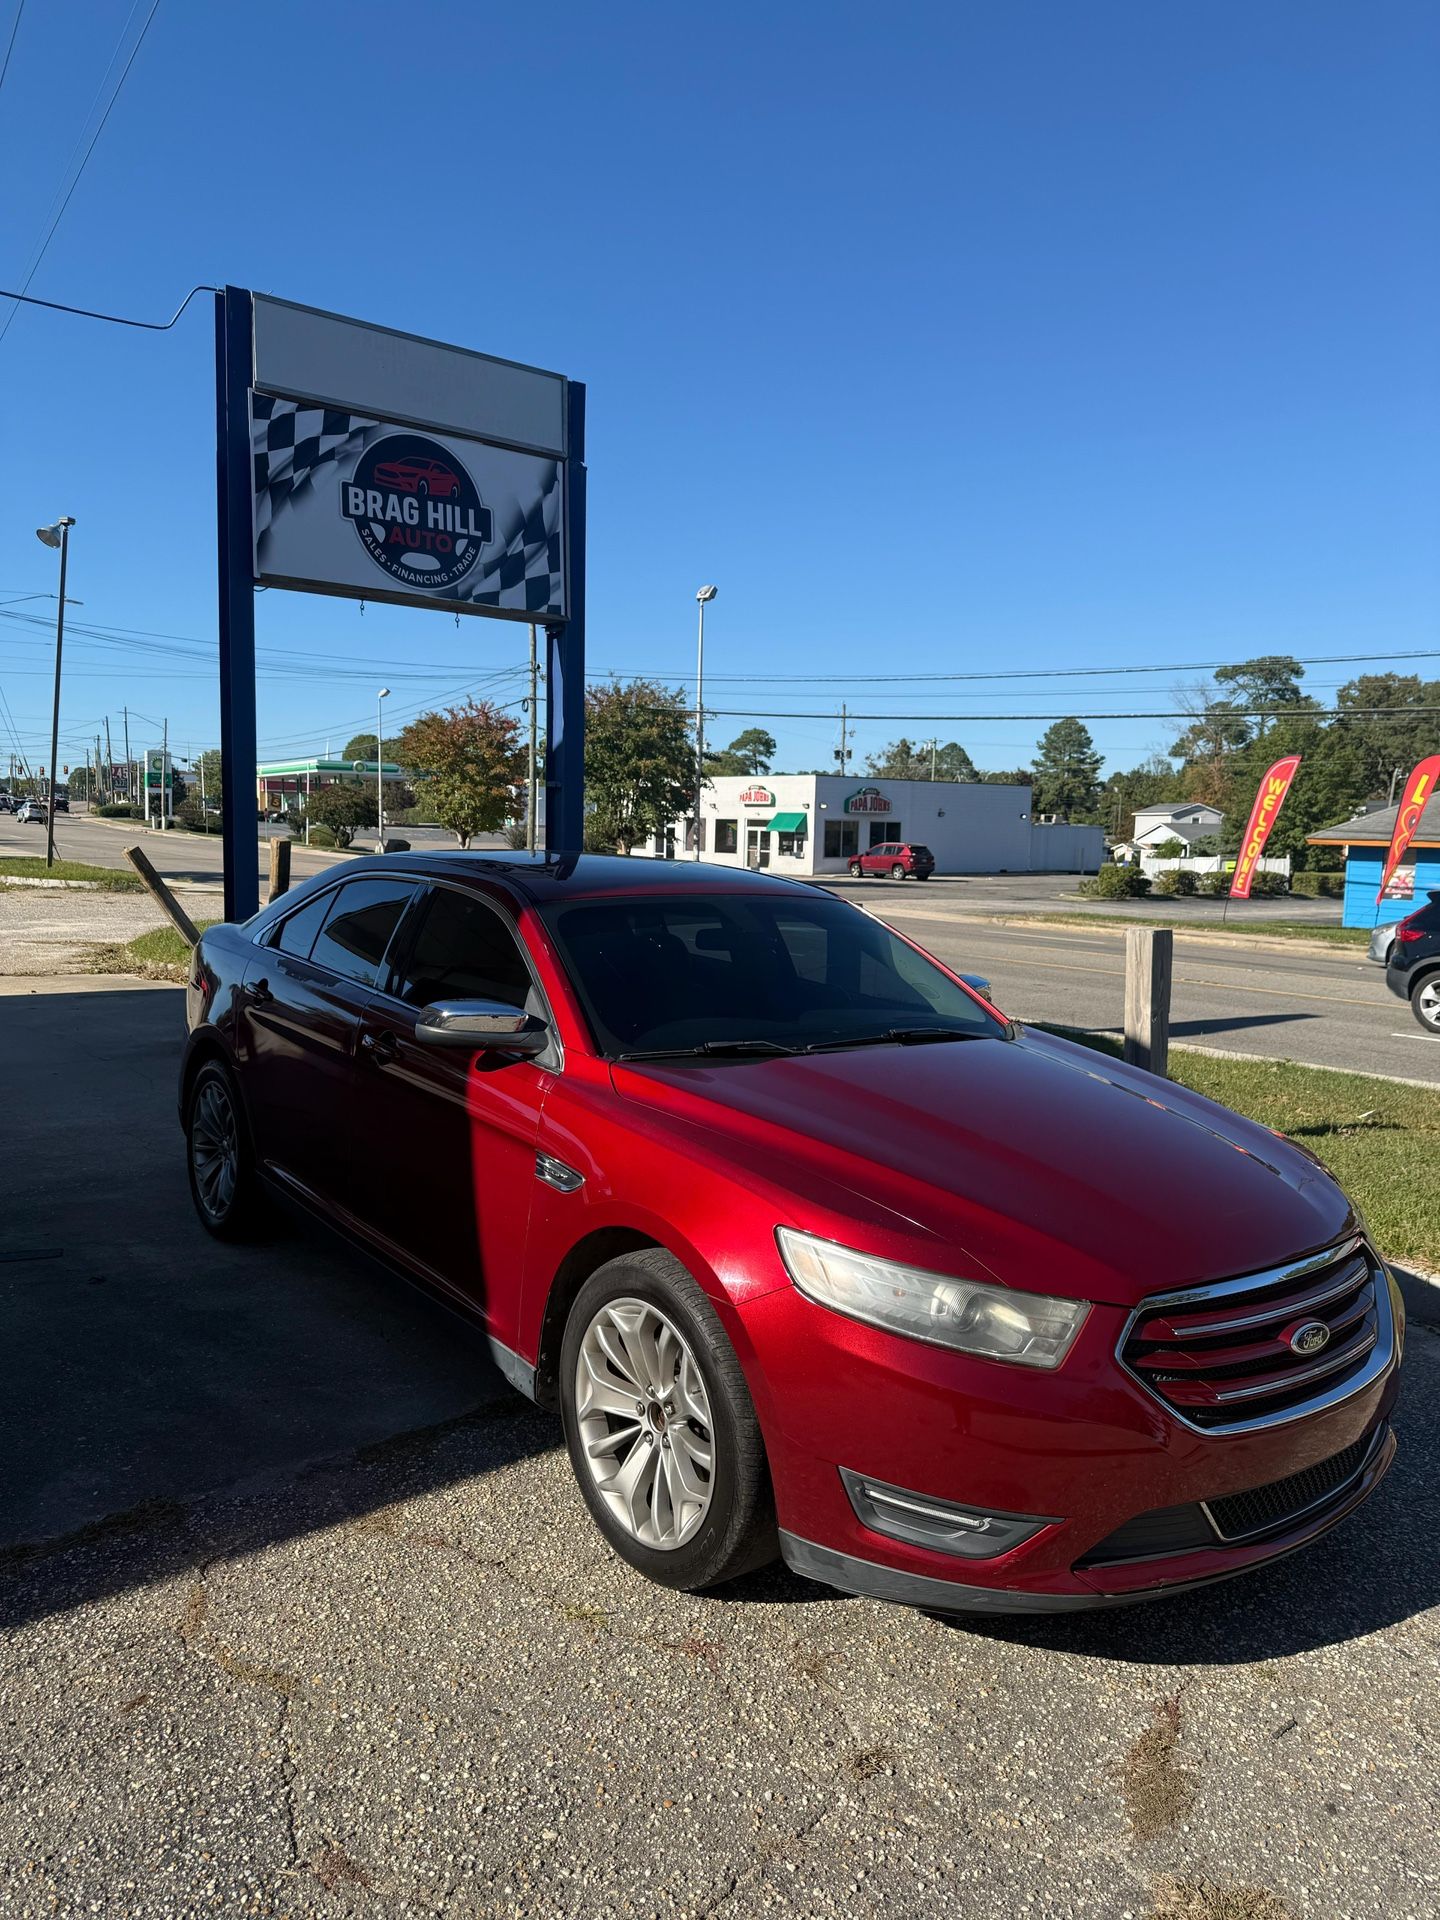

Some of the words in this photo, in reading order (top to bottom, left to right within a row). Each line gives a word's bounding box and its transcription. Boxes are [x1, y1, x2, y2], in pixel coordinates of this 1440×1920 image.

[348, 486, 419, 525] BRAG
[427, 500, 482, 537] HILL
[389, 525, 453, 553] AUTO
[361, 528, 387, 563] SALES
[391, 563, 448, 584] FINANCING
[452, 546, 476, 575] TRADE
[850, 796, 868, 812] PAPA
[1303, 1328, 1323, 1349] Ford
